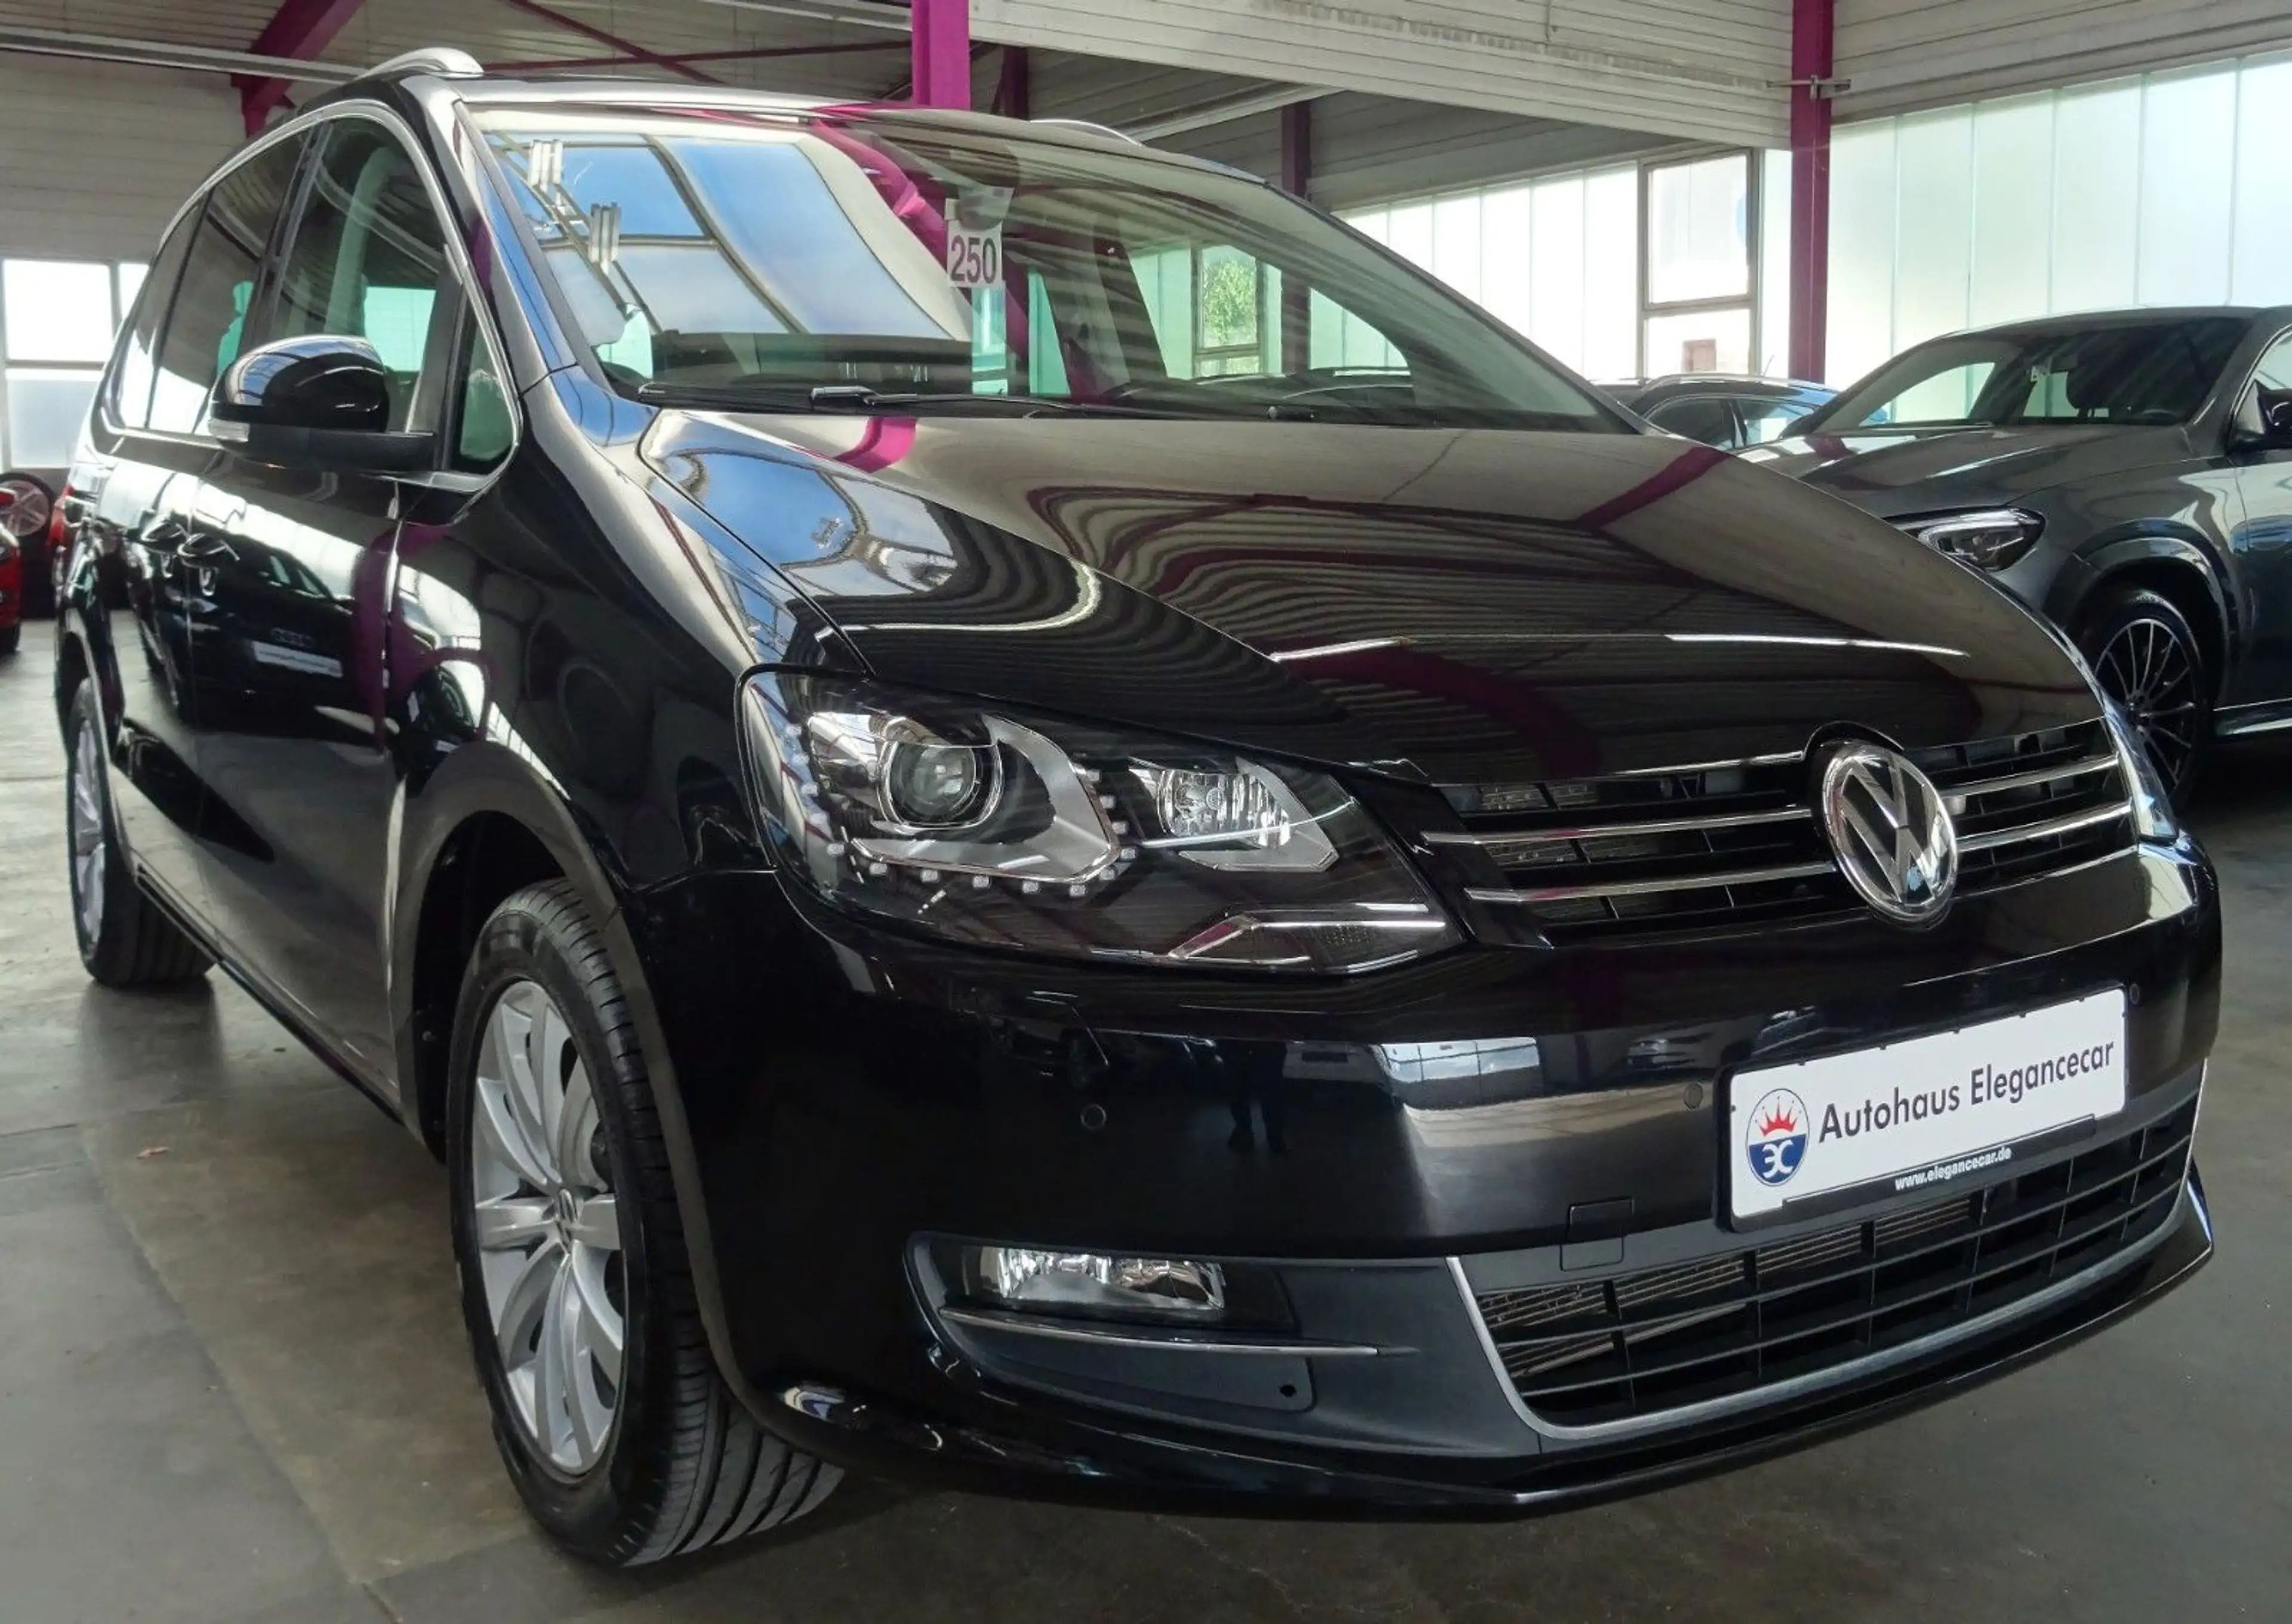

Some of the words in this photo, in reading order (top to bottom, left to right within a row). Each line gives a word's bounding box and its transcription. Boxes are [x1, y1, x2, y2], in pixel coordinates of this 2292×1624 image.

[950, 235, 997, 284] 250
[1819, 1086, 1960, 1142] Autohaus
[1971, 1041, 2114, 1106] Elegancecar
[1894, 1146, 2012, 1191] www.elegancecar.de
